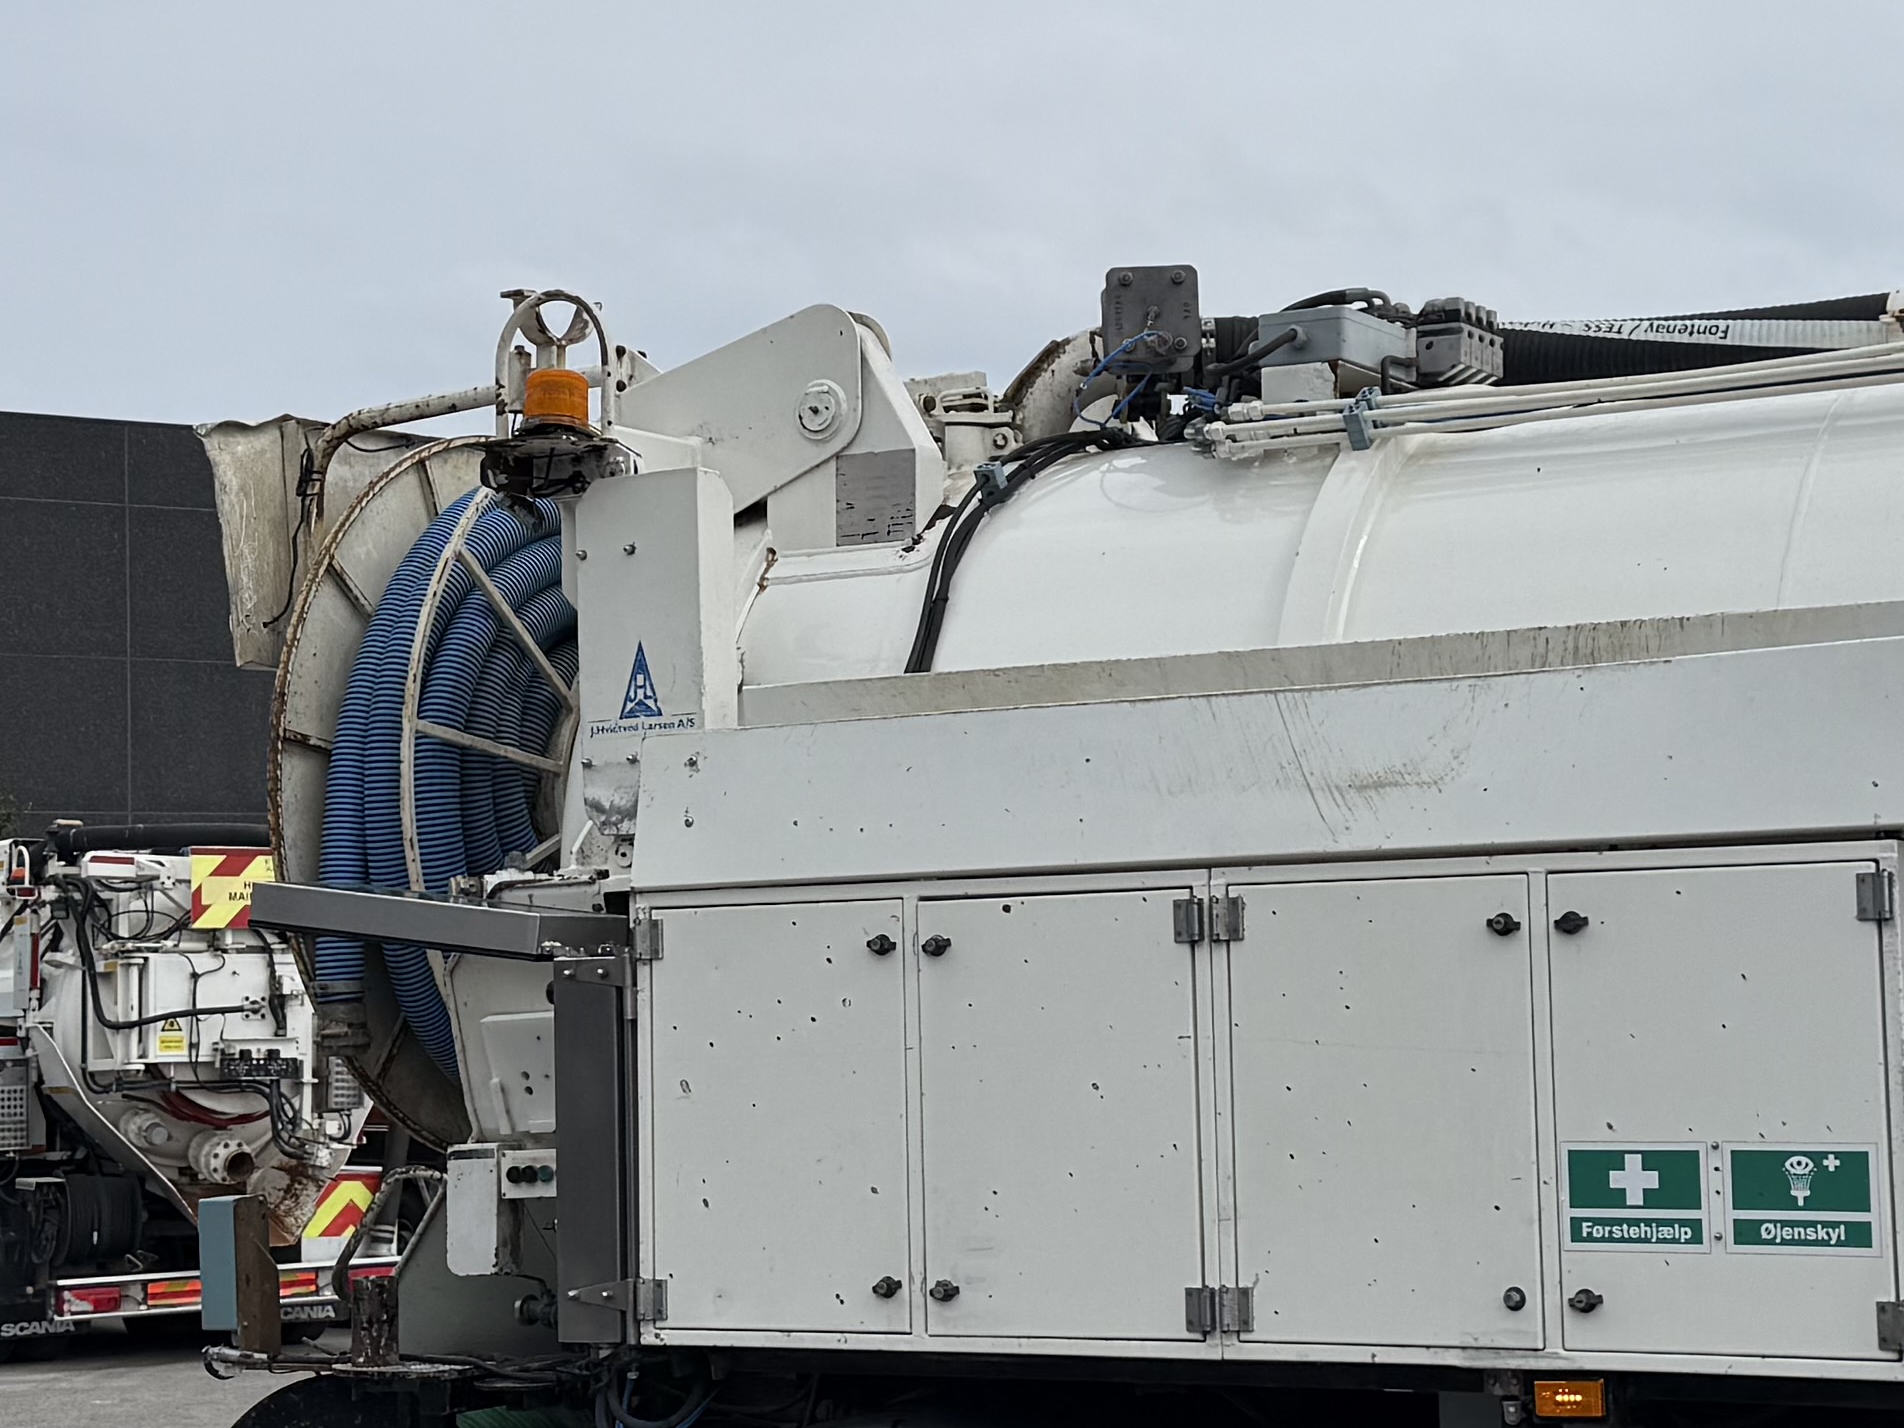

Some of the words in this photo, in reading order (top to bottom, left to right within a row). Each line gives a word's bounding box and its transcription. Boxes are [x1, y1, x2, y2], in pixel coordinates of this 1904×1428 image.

[1646, 322, 1730, 340] Fontenay
[677, 717, 695, 729] A/S
[1582, 1222, 1693, 1243] Førstehjælp
[1760, 1222, 1846, 1244] Øjenskyl
[280, 1304, 336, 1320] CANIA
[0, 1320, 75, 1337] SCANIA
